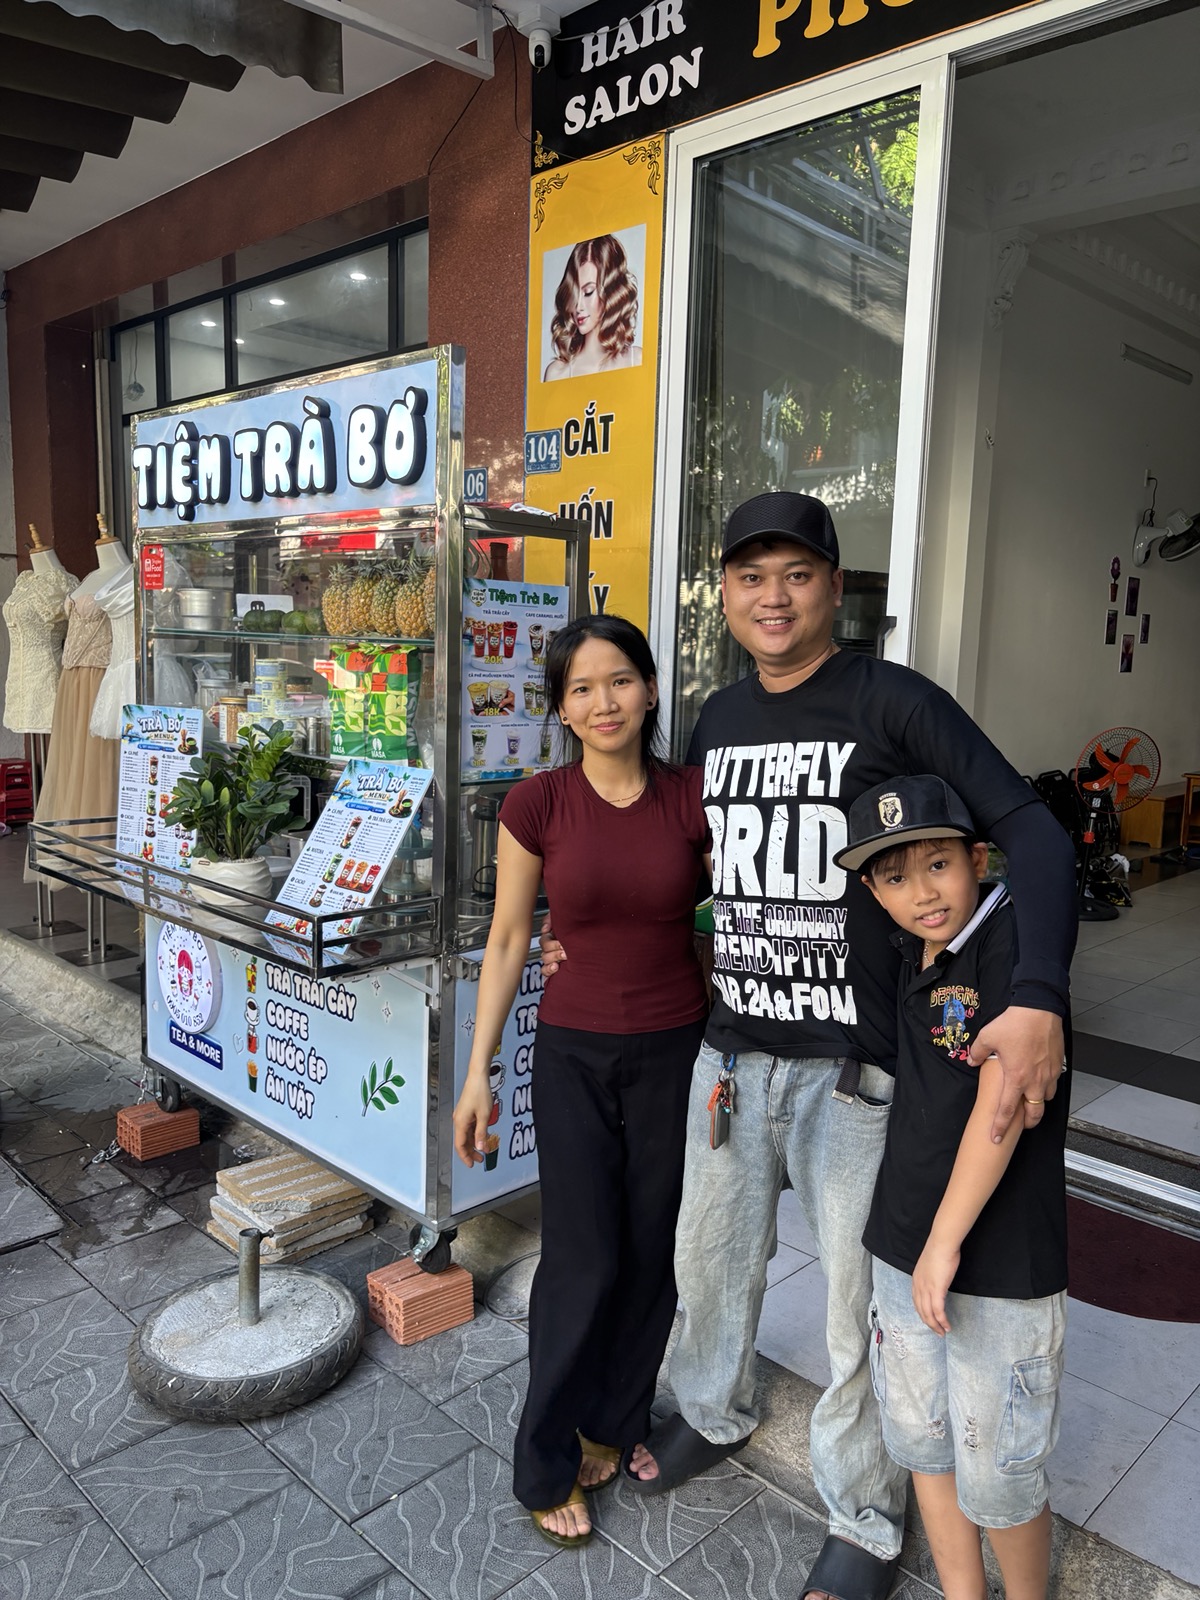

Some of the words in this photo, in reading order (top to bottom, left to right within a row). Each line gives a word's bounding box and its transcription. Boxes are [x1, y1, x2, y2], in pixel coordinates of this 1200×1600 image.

[580, 0, 686, 72] HAIR
[564, 47, 703, 135] SALON
[528, 435, 558, 463] 104
[564, 401, 614, 457] CẮT
[133, 420, 231, 520] TIỆM
[234, 395, 337, 501] TRÀ
[347, 386, 428, 489] BƠ
[464, 472, 485, 498] 06
[488, 588, 518, 605] Tiệm
[520, 591, 540, 605] Trà
[542, 592, 558, 606] Bơ
[484, 656, 504, 665] 20K
[703, 742, 857, 800] BUTTERFLY
[733, 902, 764, 935] THE
[765, 904, 848, 940] ORDINARY
[265, 963, 292, 997] TRÀ
[326, 983, 357, 1022] CÂY
[520, 962, 545, 996] TR
[265, 999, 309, 1042] COFFE
[515, 1003, 538, 1036] TR
[171, 1026, 188, 1047] TEA
[188, 1037, 196, 1051] &
[196, 1042, 221, 1064] MORE
[265, 1034, 306, 1077] NƯỚC
[307, 1046, 328, 1085] ÉP
[265, 1065, 286, 1105] ĂN
[287, 1080, 315, 1120] VẶT
[509, 1121, 537, 1161] ĂN
